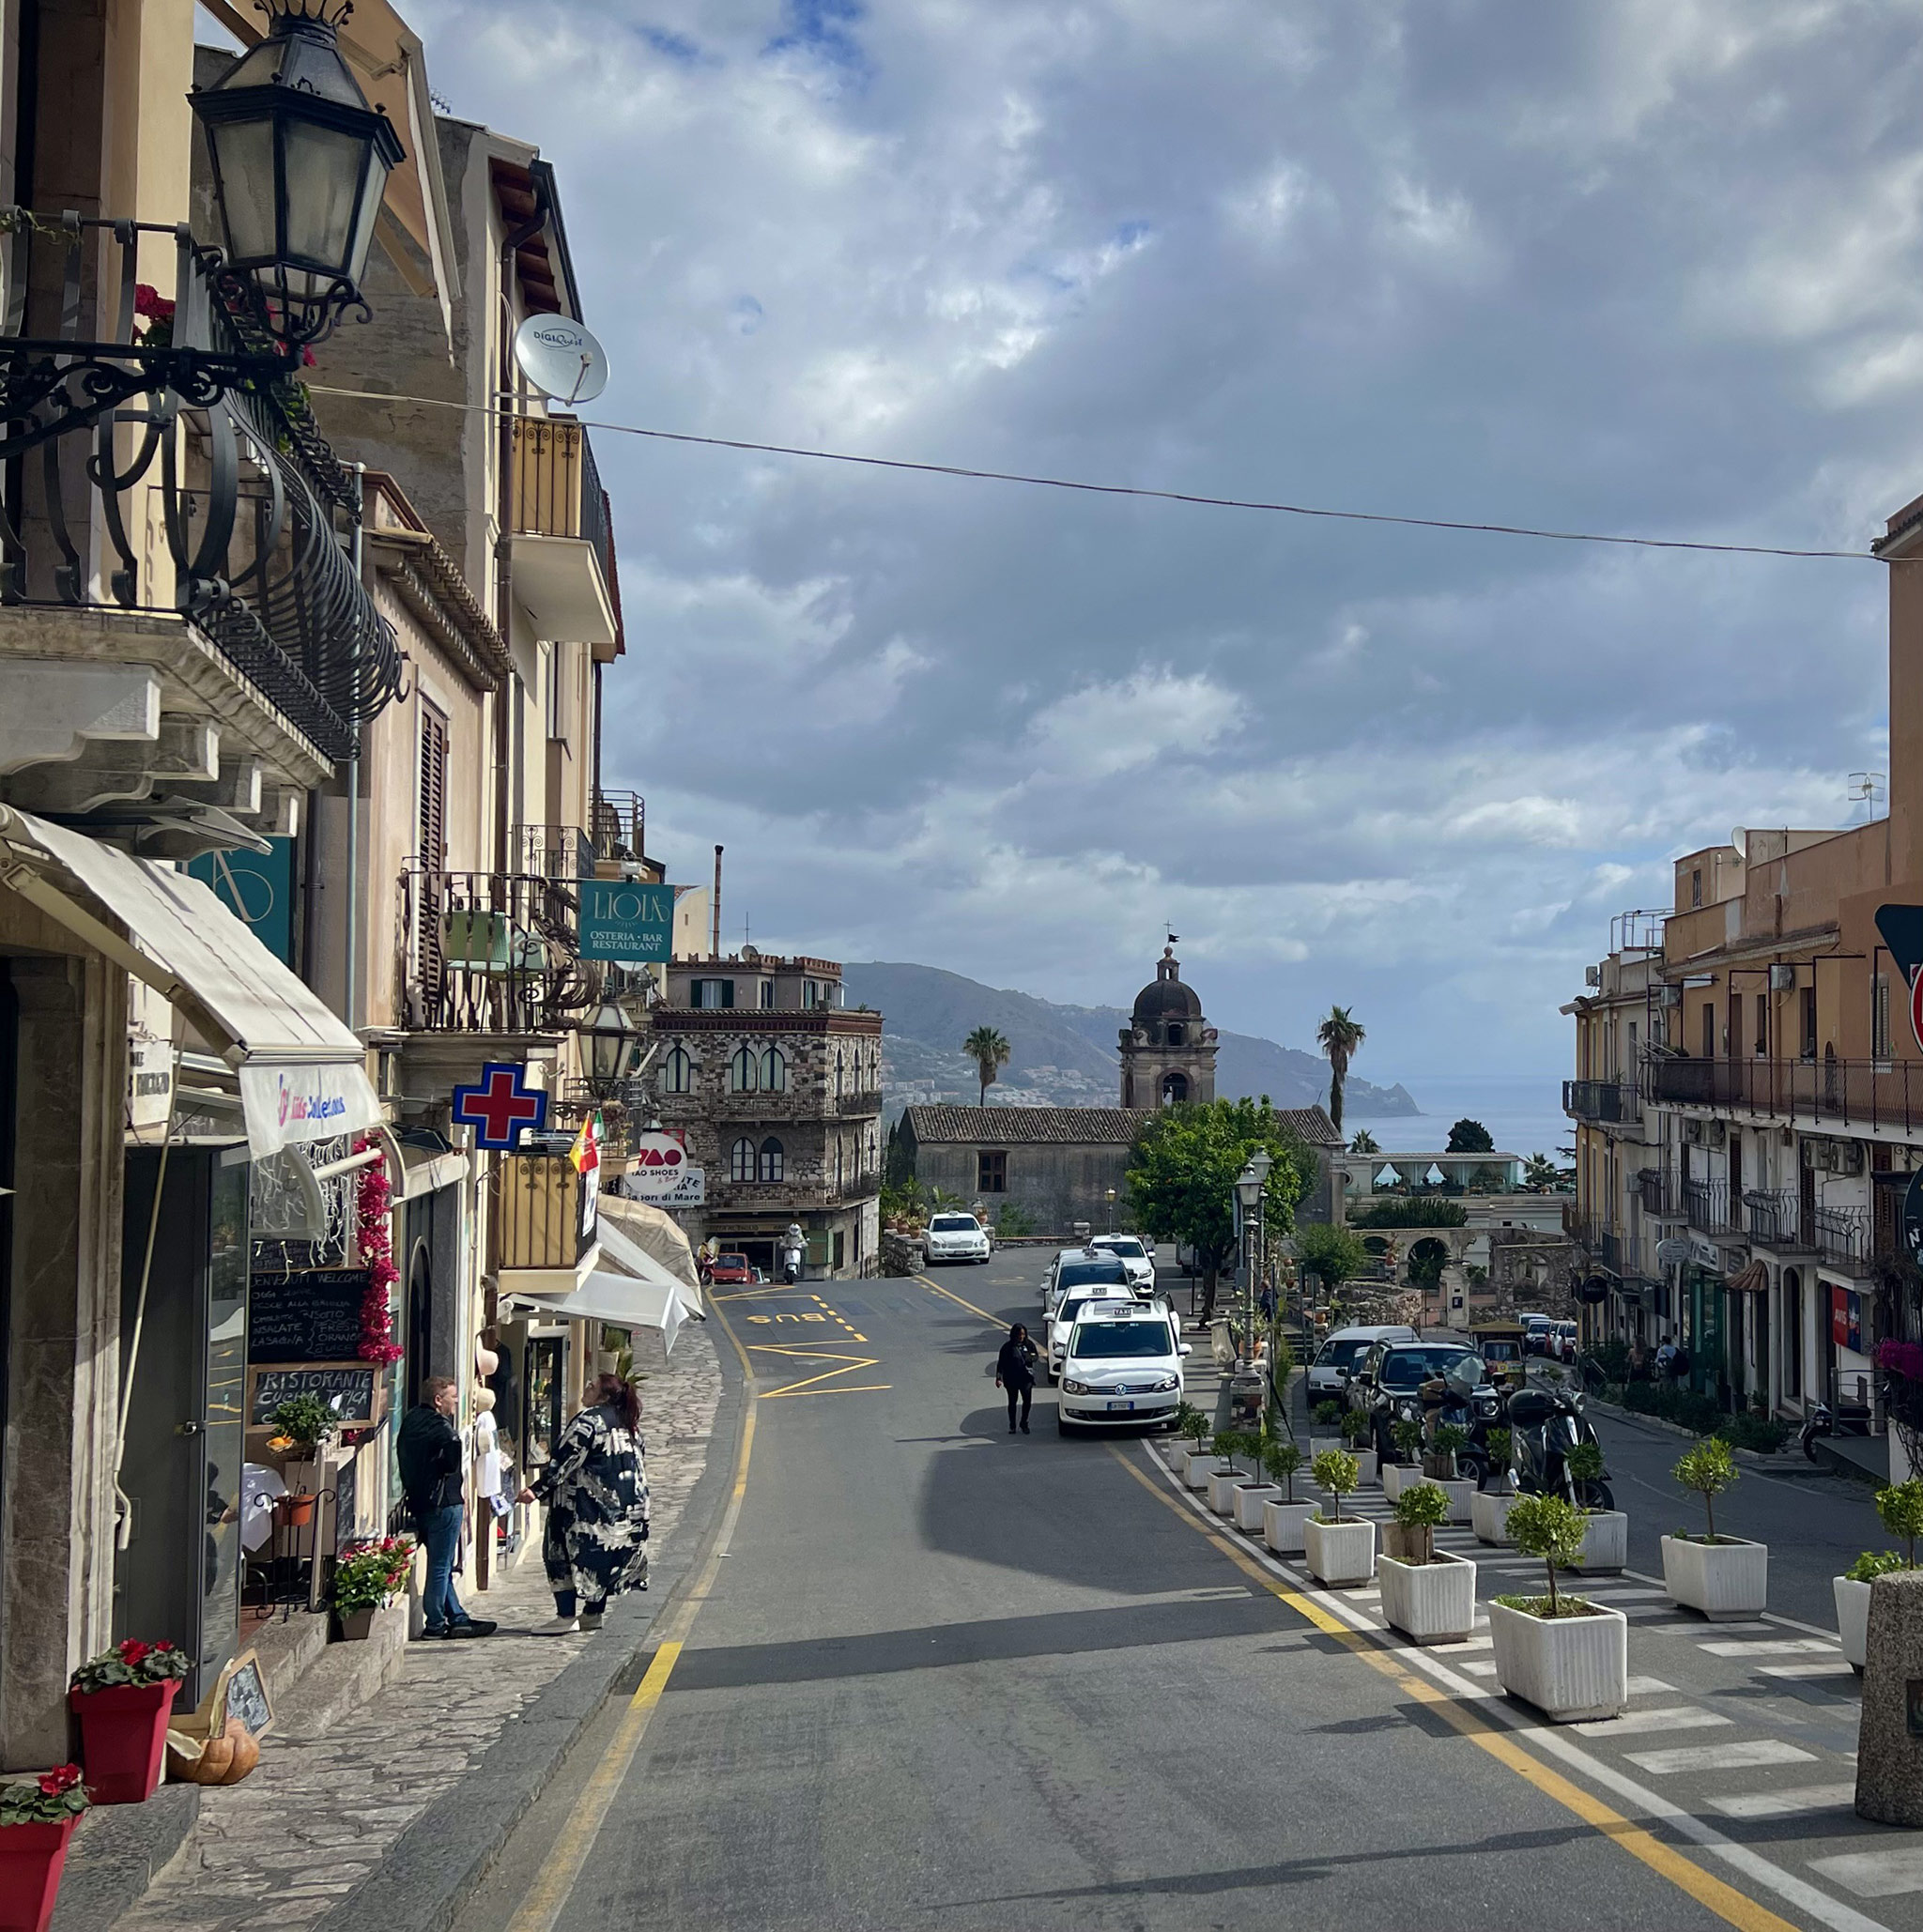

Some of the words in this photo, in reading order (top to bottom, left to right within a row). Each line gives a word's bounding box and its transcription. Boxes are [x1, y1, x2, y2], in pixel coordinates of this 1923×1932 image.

[590, 930, 635, 942] OSTERIA
[642, 933, 663, 943] BAR
[592, 940, 661, 952] RESTAURANT
[627, 1193, 658, 1202] Saori
[661, 1192, 672, 1202] di
[674, 1193, 700, 1202] Mare
[317, 1272, 367, 1283] WELCOME
[746, 1312, 826, 1324] BUS
[319, 1322, 359, 1332] FRESH
[251, 1334, 303, 1347] LASAGNA
[264, 1370, 373, 1390] RISTORANTE
[326, 1389, 367, 1405] TPICA
